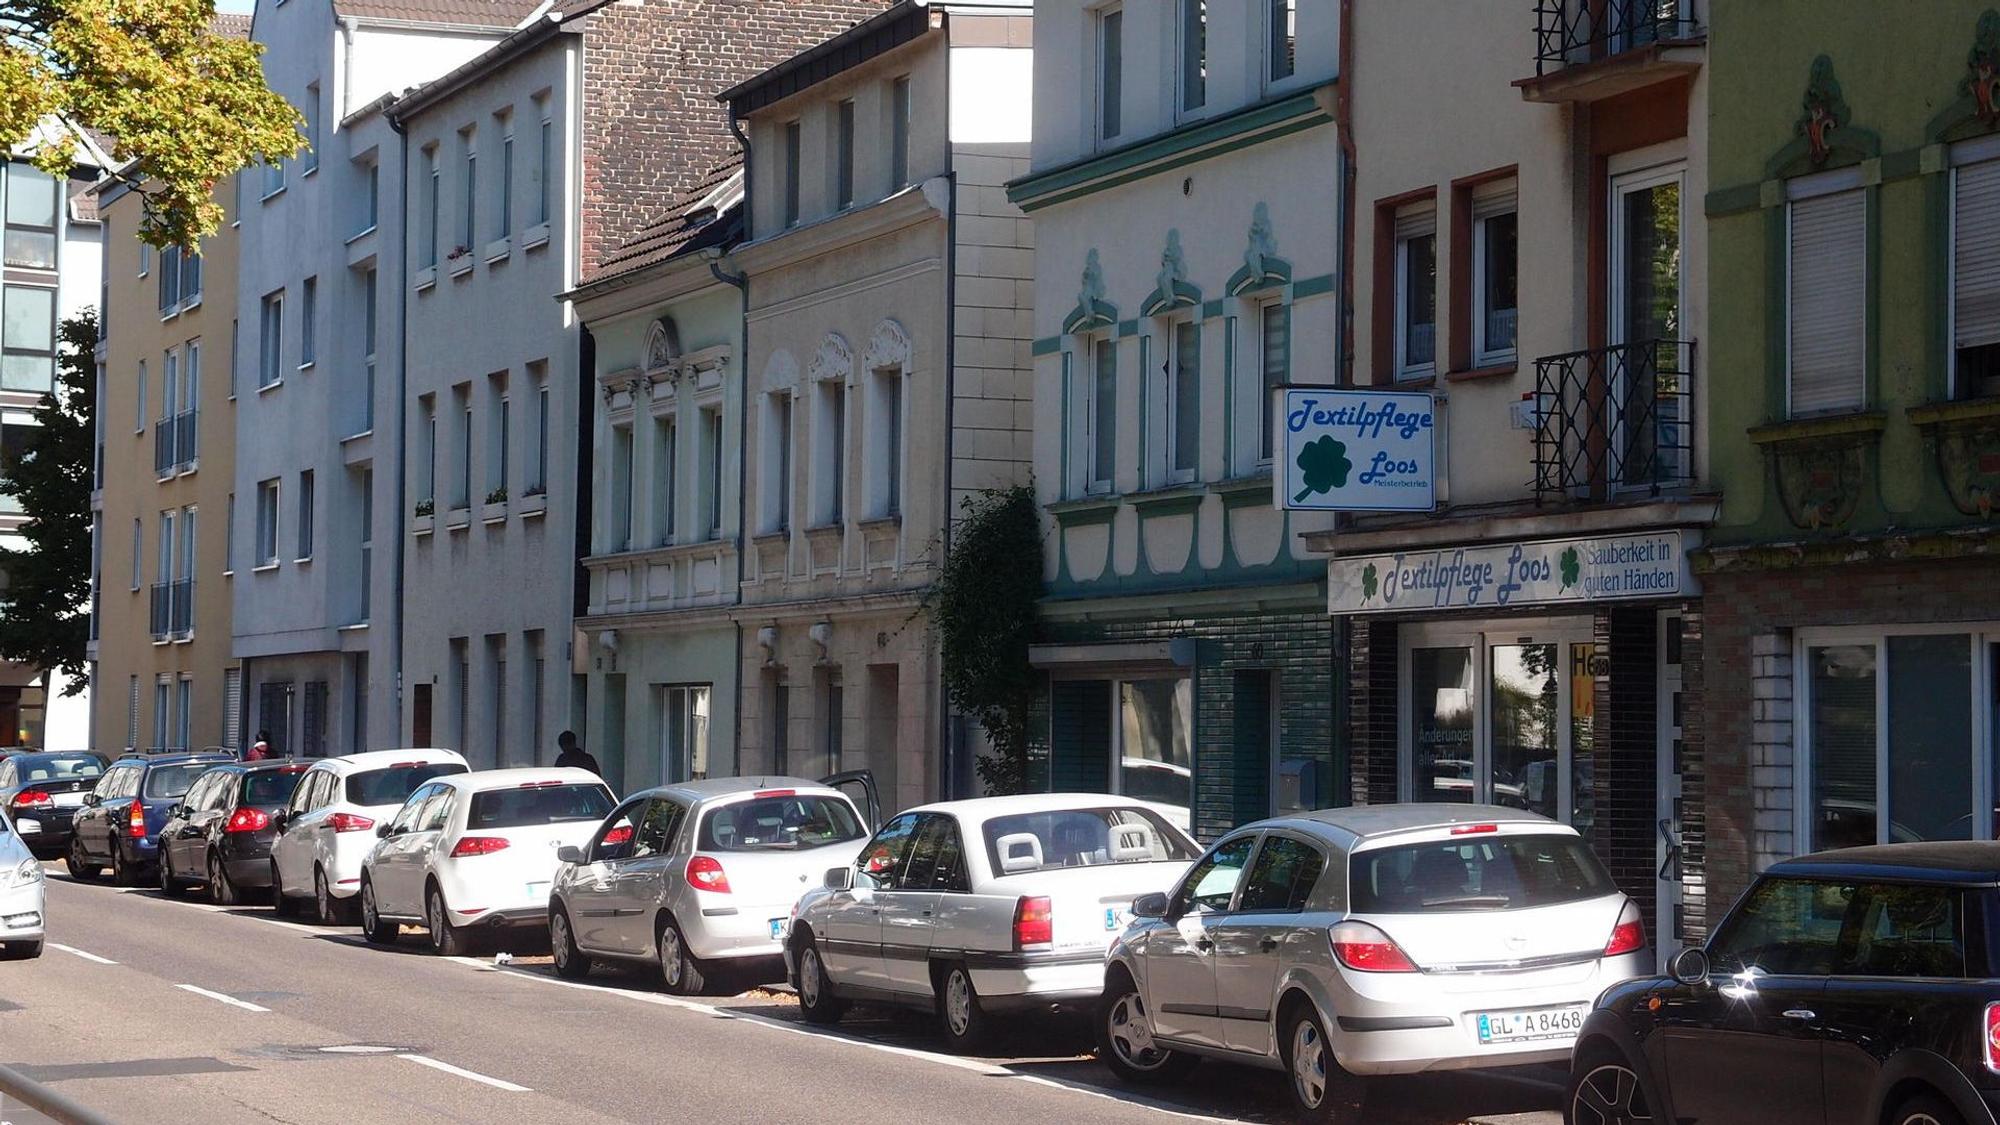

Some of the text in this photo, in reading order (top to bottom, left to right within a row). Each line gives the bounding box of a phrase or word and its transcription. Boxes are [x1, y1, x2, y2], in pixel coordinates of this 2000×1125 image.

[1287, 399, 1434, 440] Textilpflege
[1359, 450, 1419, 485] Loos
[1373, 478, 1428, 489] Meisterbetrieb
[1587, 538, 1671, 566] Sauberkeit in
[1383, 543, 1551, 608] Textilpflege Loos
[1584, 566, 1674, 600] guten Händen
[1490, 1010, 1582, 1035] GL A 8468
